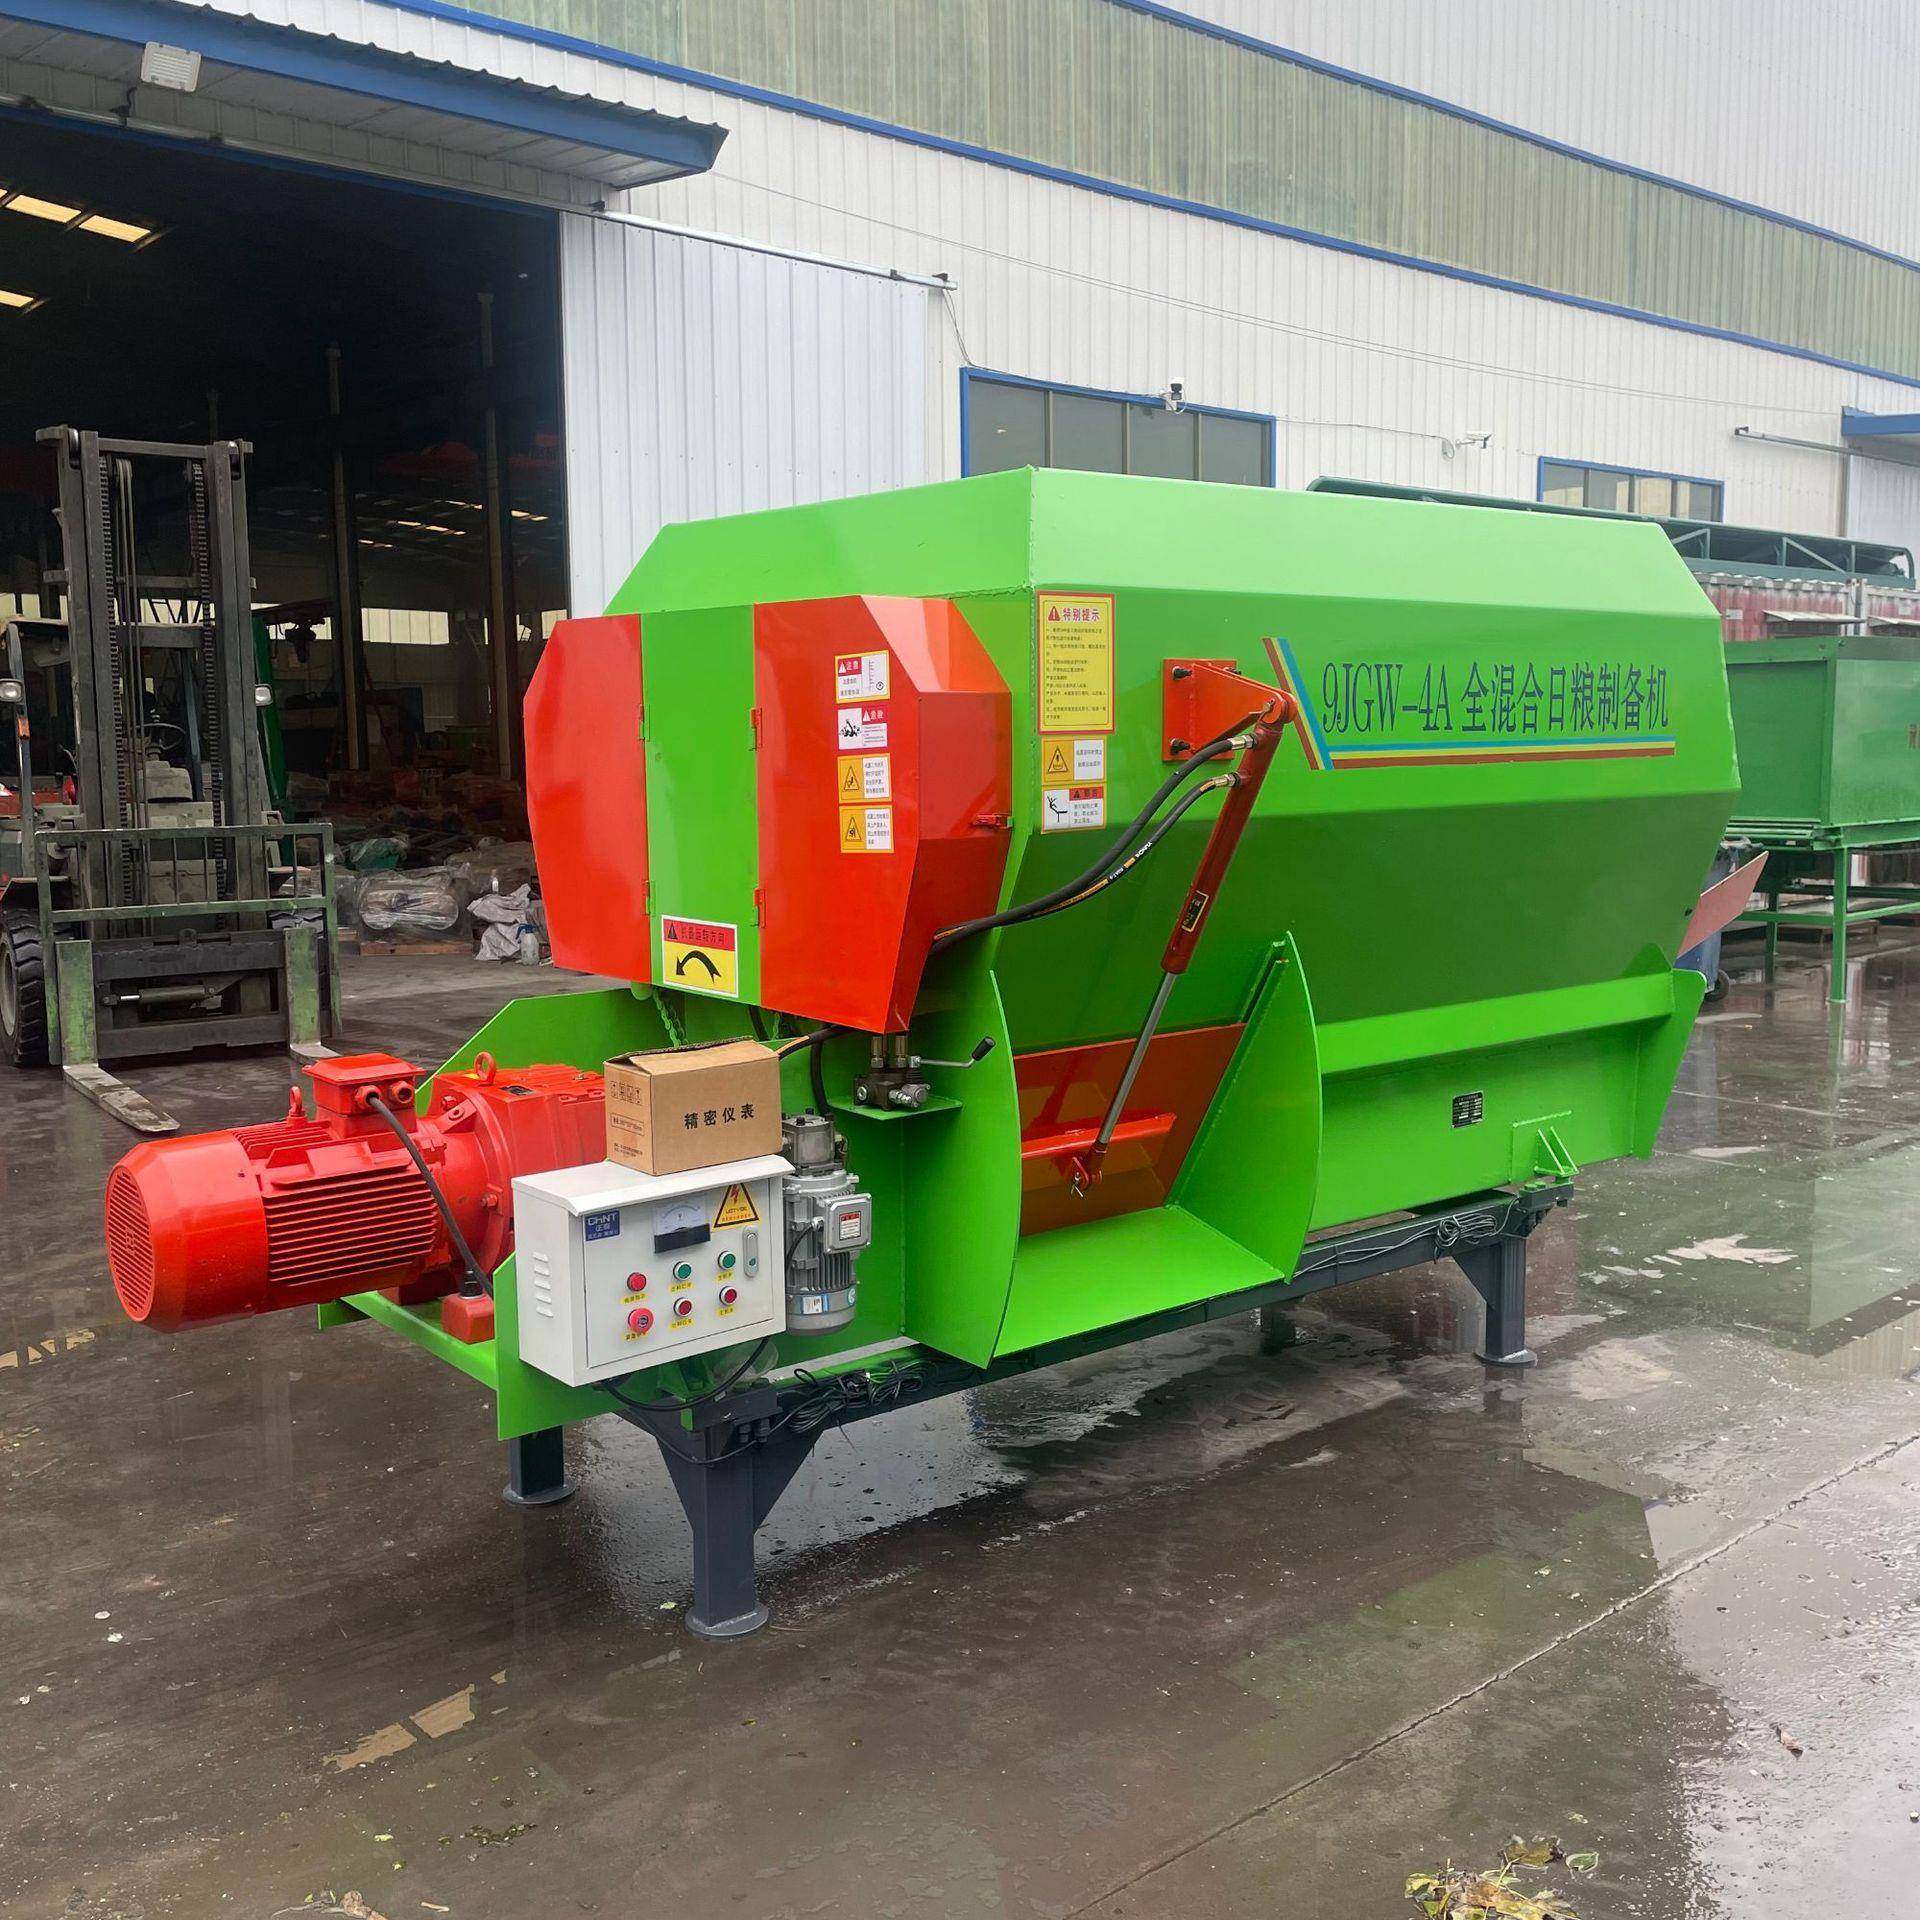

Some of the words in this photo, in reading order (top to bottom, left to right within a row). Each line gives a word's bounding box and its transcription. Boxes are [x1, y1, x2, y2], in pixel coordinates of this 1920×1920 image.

[1062, 607, 1100, 622] 特别提示
[1322, 662, 1453, 733] 9JGW-4A
[1460, 661, 1669, 734] 全混合日粮制备机
[683, 1103, 755, 1130] 精密仪表
